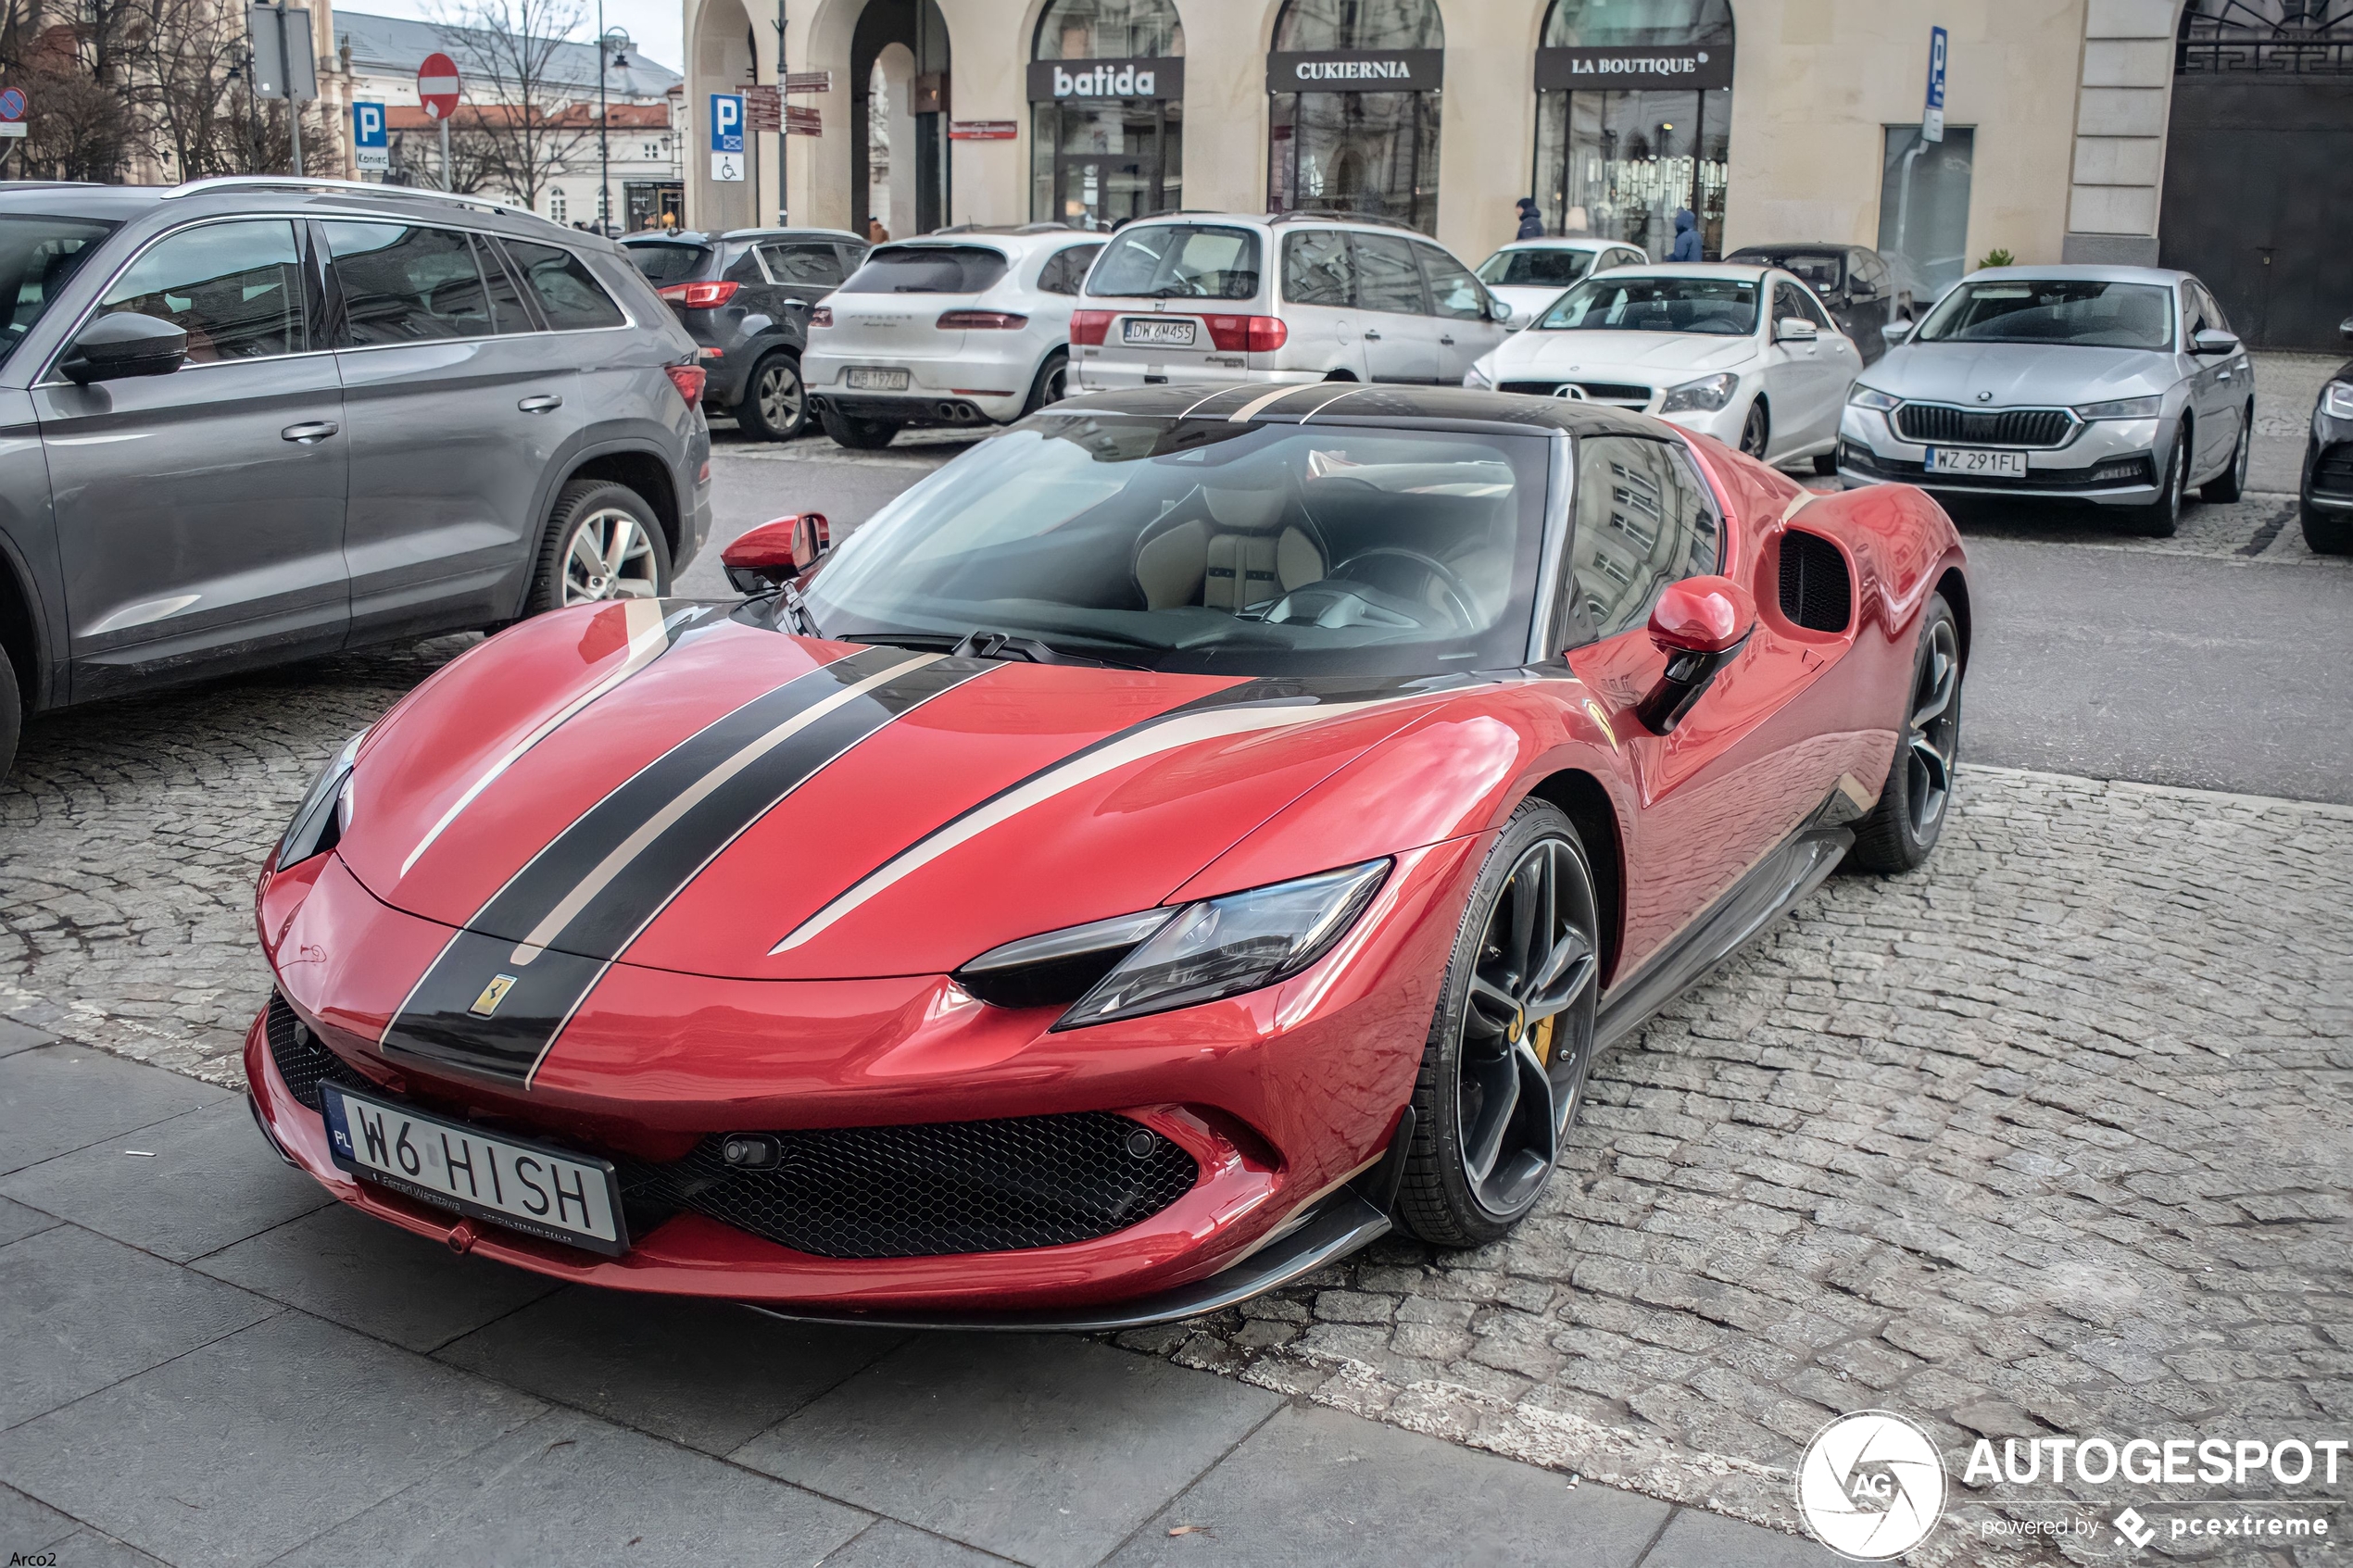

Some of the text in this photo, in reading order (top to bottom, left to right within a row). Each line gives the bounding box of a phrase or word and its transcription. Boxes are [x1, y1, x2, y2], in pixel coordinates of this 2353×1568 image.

[1296, 61, 1410, 80] CUKIERNIA
[1572, 58, 1695, 75] LA BOUTIQUE
[1931, 33, 1944, 83] P
[1053, 64, 1155, 96] batida
[359, 107, 380, 142] P
[717, 98, 737, 135] P
[1938, 451, 2021, 471] WZ 291FL
[334, 1130, 351, 1148] PL
[358, 1106, 592, 1230] W6 HISH
